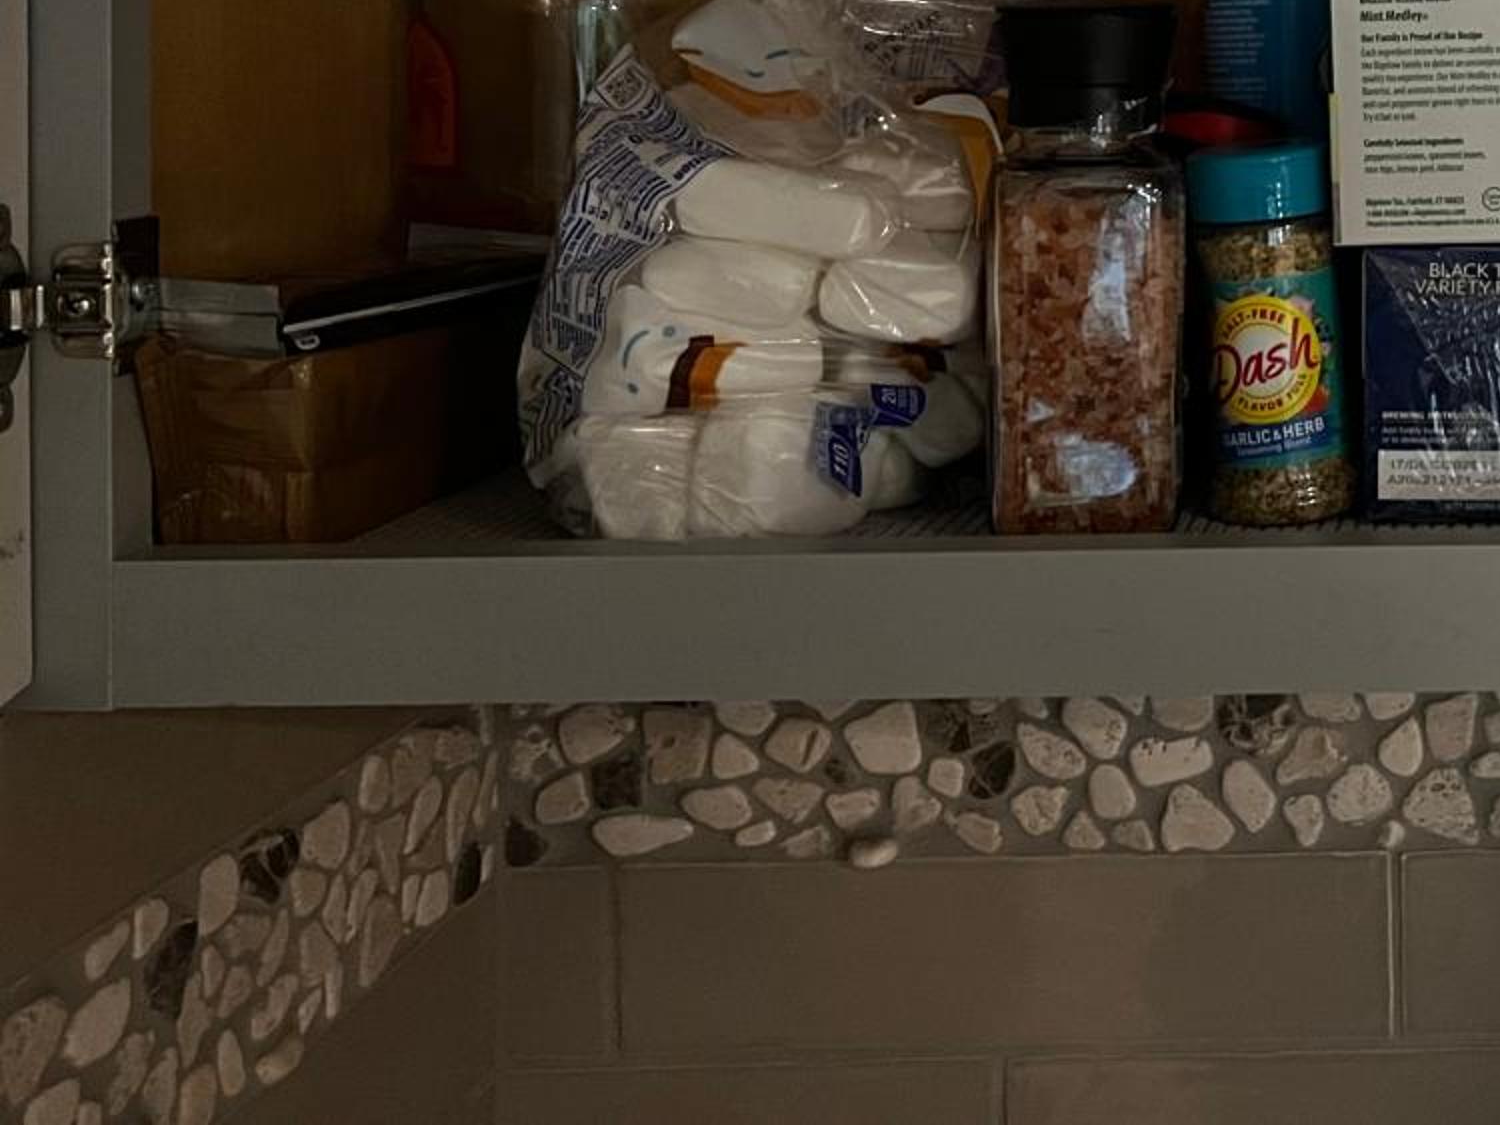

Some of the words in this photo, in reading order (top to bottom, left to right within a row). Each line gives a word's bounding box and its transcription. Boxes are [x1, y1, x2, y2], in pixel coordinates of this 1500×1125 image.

[1360, 10, 1382, 22] Mint
[1429, 261, 1489, 279] BLACK
[1414, 277, 1494, 296] VARIETY
[1215, 317, 1320, 405] Dash
